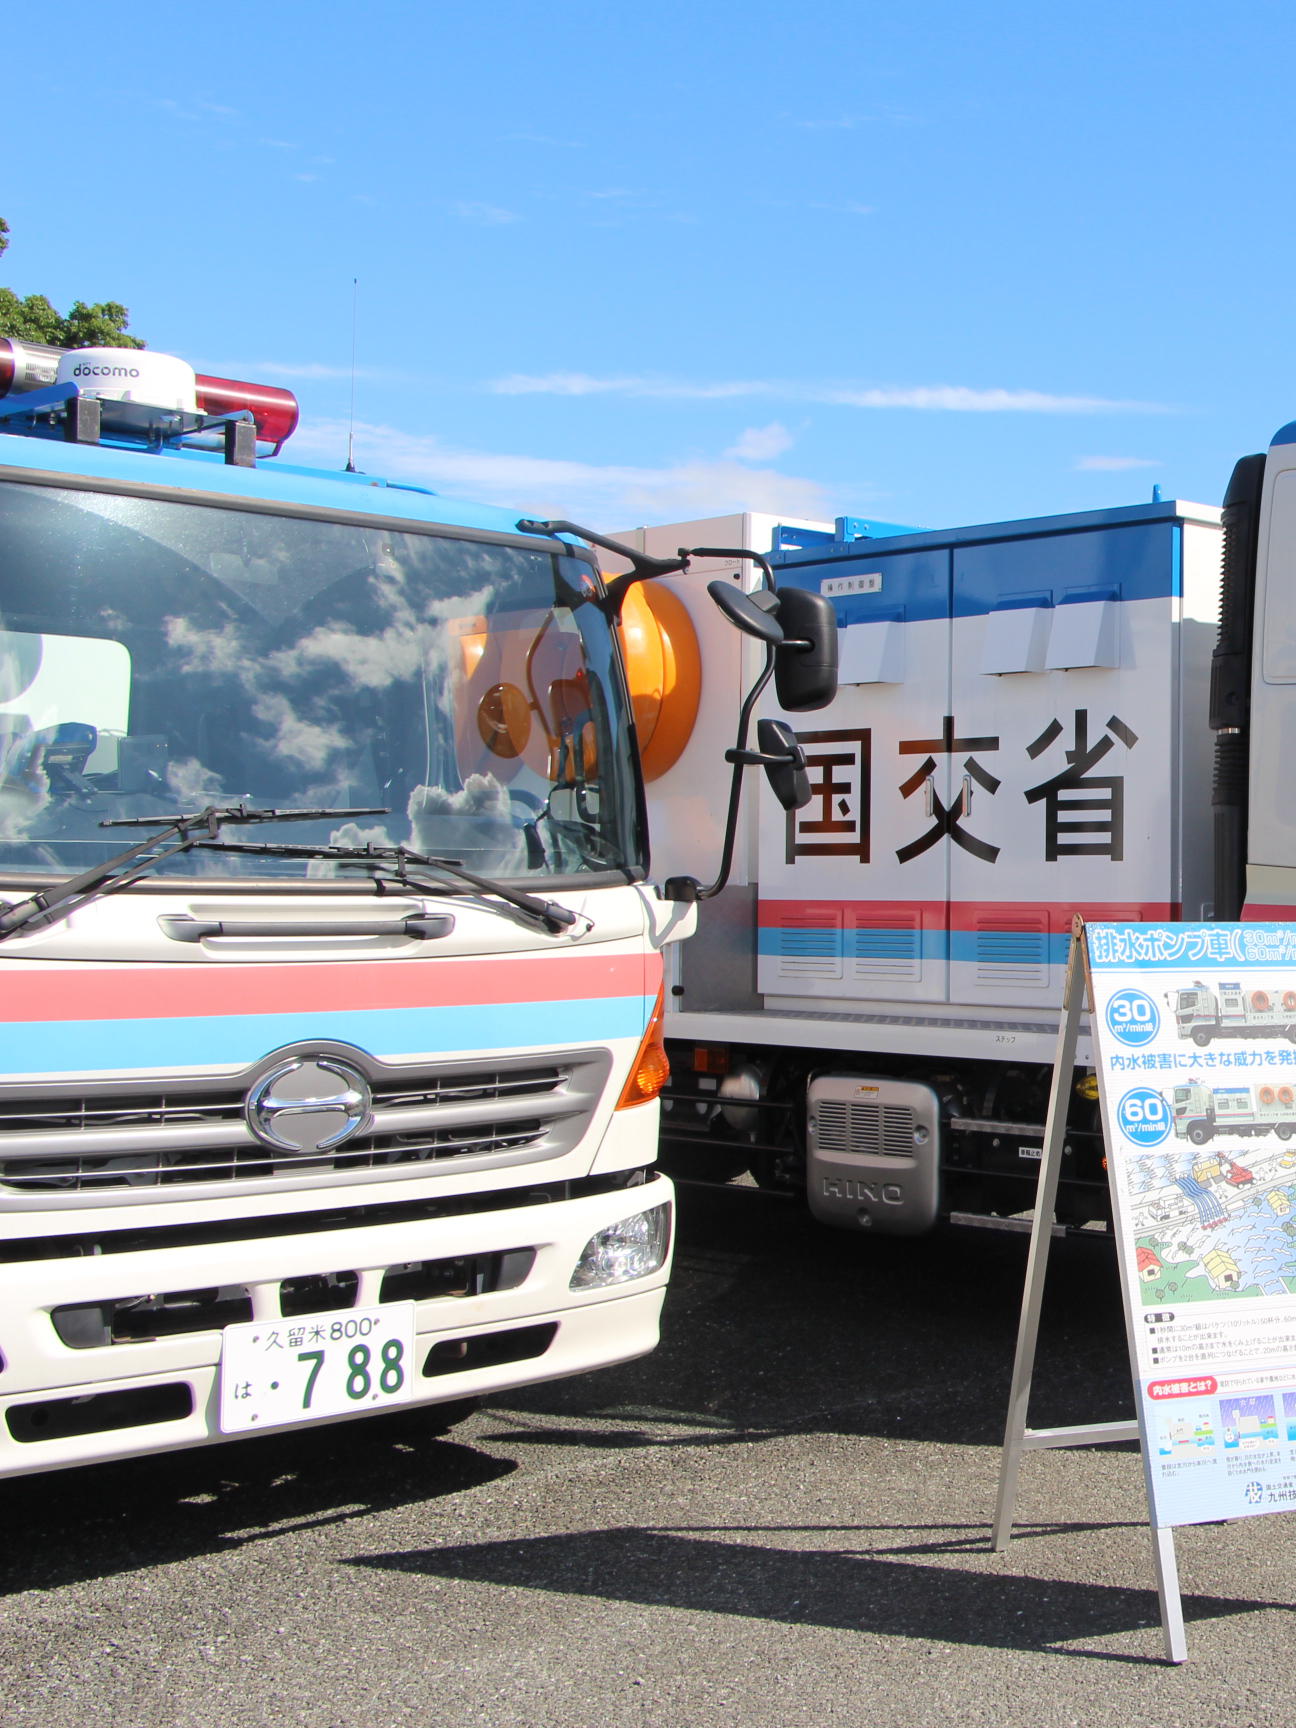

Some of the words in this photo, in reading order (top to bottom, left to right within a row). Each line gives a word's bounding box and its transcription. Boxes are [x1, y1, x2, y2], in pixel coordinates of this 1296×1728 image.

[73, 363, 139, 377] docomo
[1113, 999, 1151, 1022] 30
[1124, 1098, 1163, 1121] 60
[823, 1177, 905, 1206] HINO
[234, 1381, 252, 1400] は
